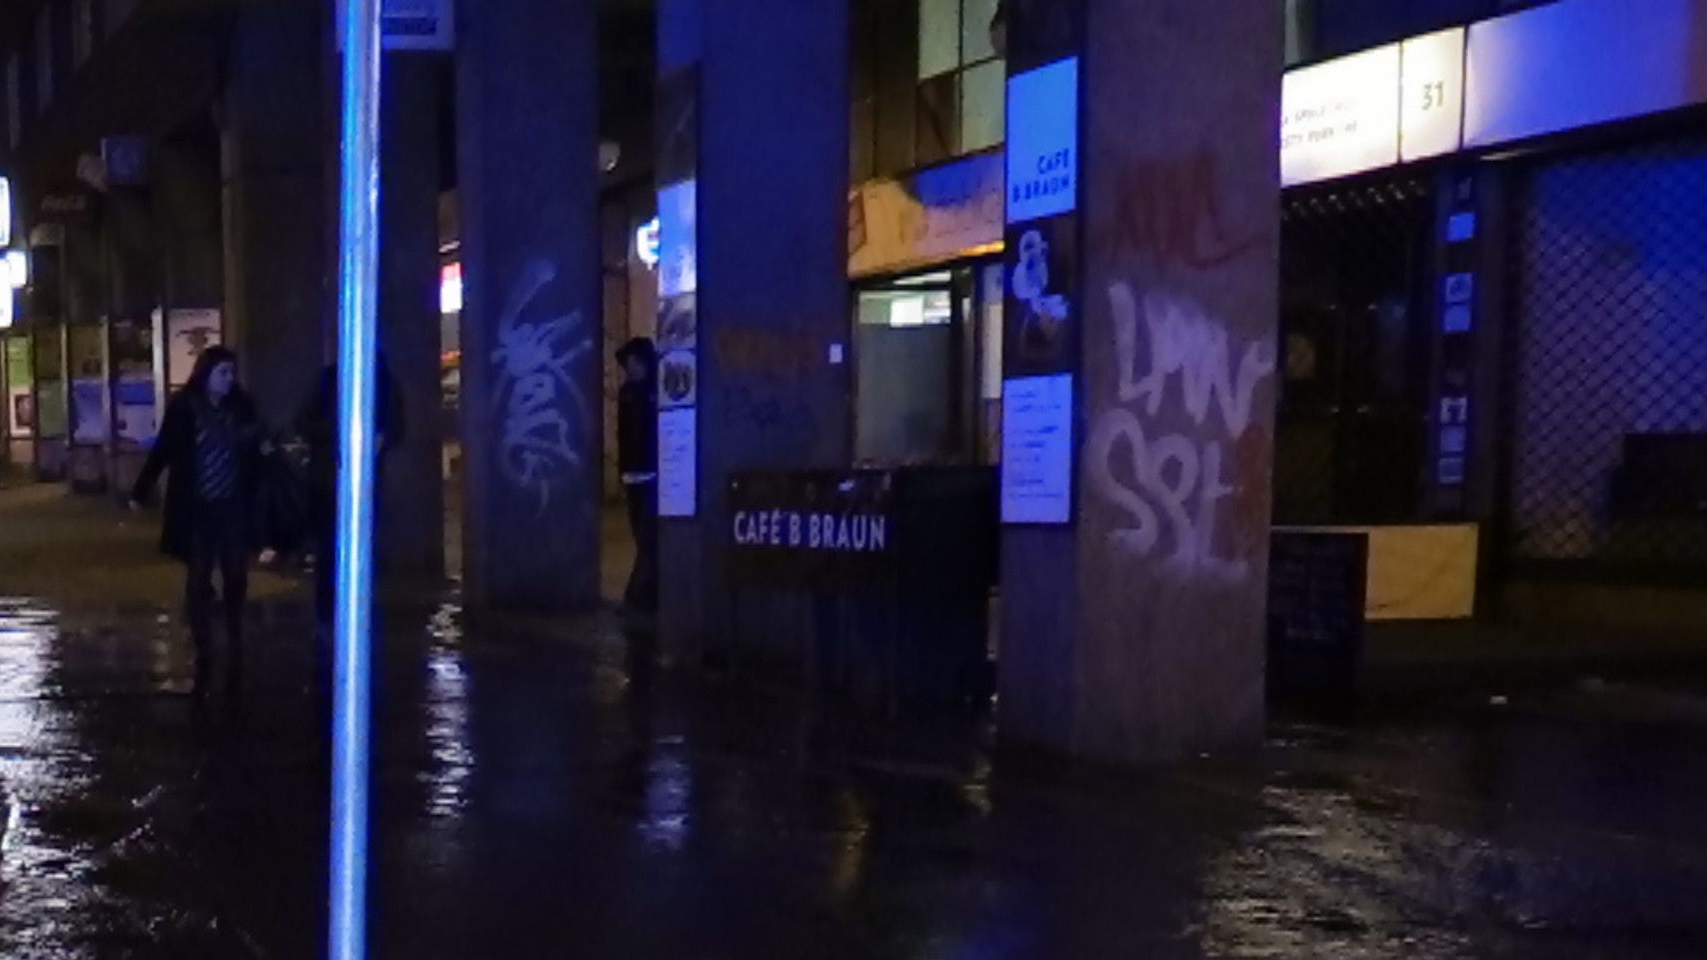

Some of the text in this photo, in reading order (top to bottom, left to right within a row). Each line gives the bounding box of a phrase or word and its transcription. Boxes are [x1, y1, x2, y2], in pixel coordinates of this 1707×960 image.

[1421, 80, 1444, 111] 31
[1024, 173, 1070, 200] BRAUN
[733, 508, 886, 551] CAFÉ B BRAUN
